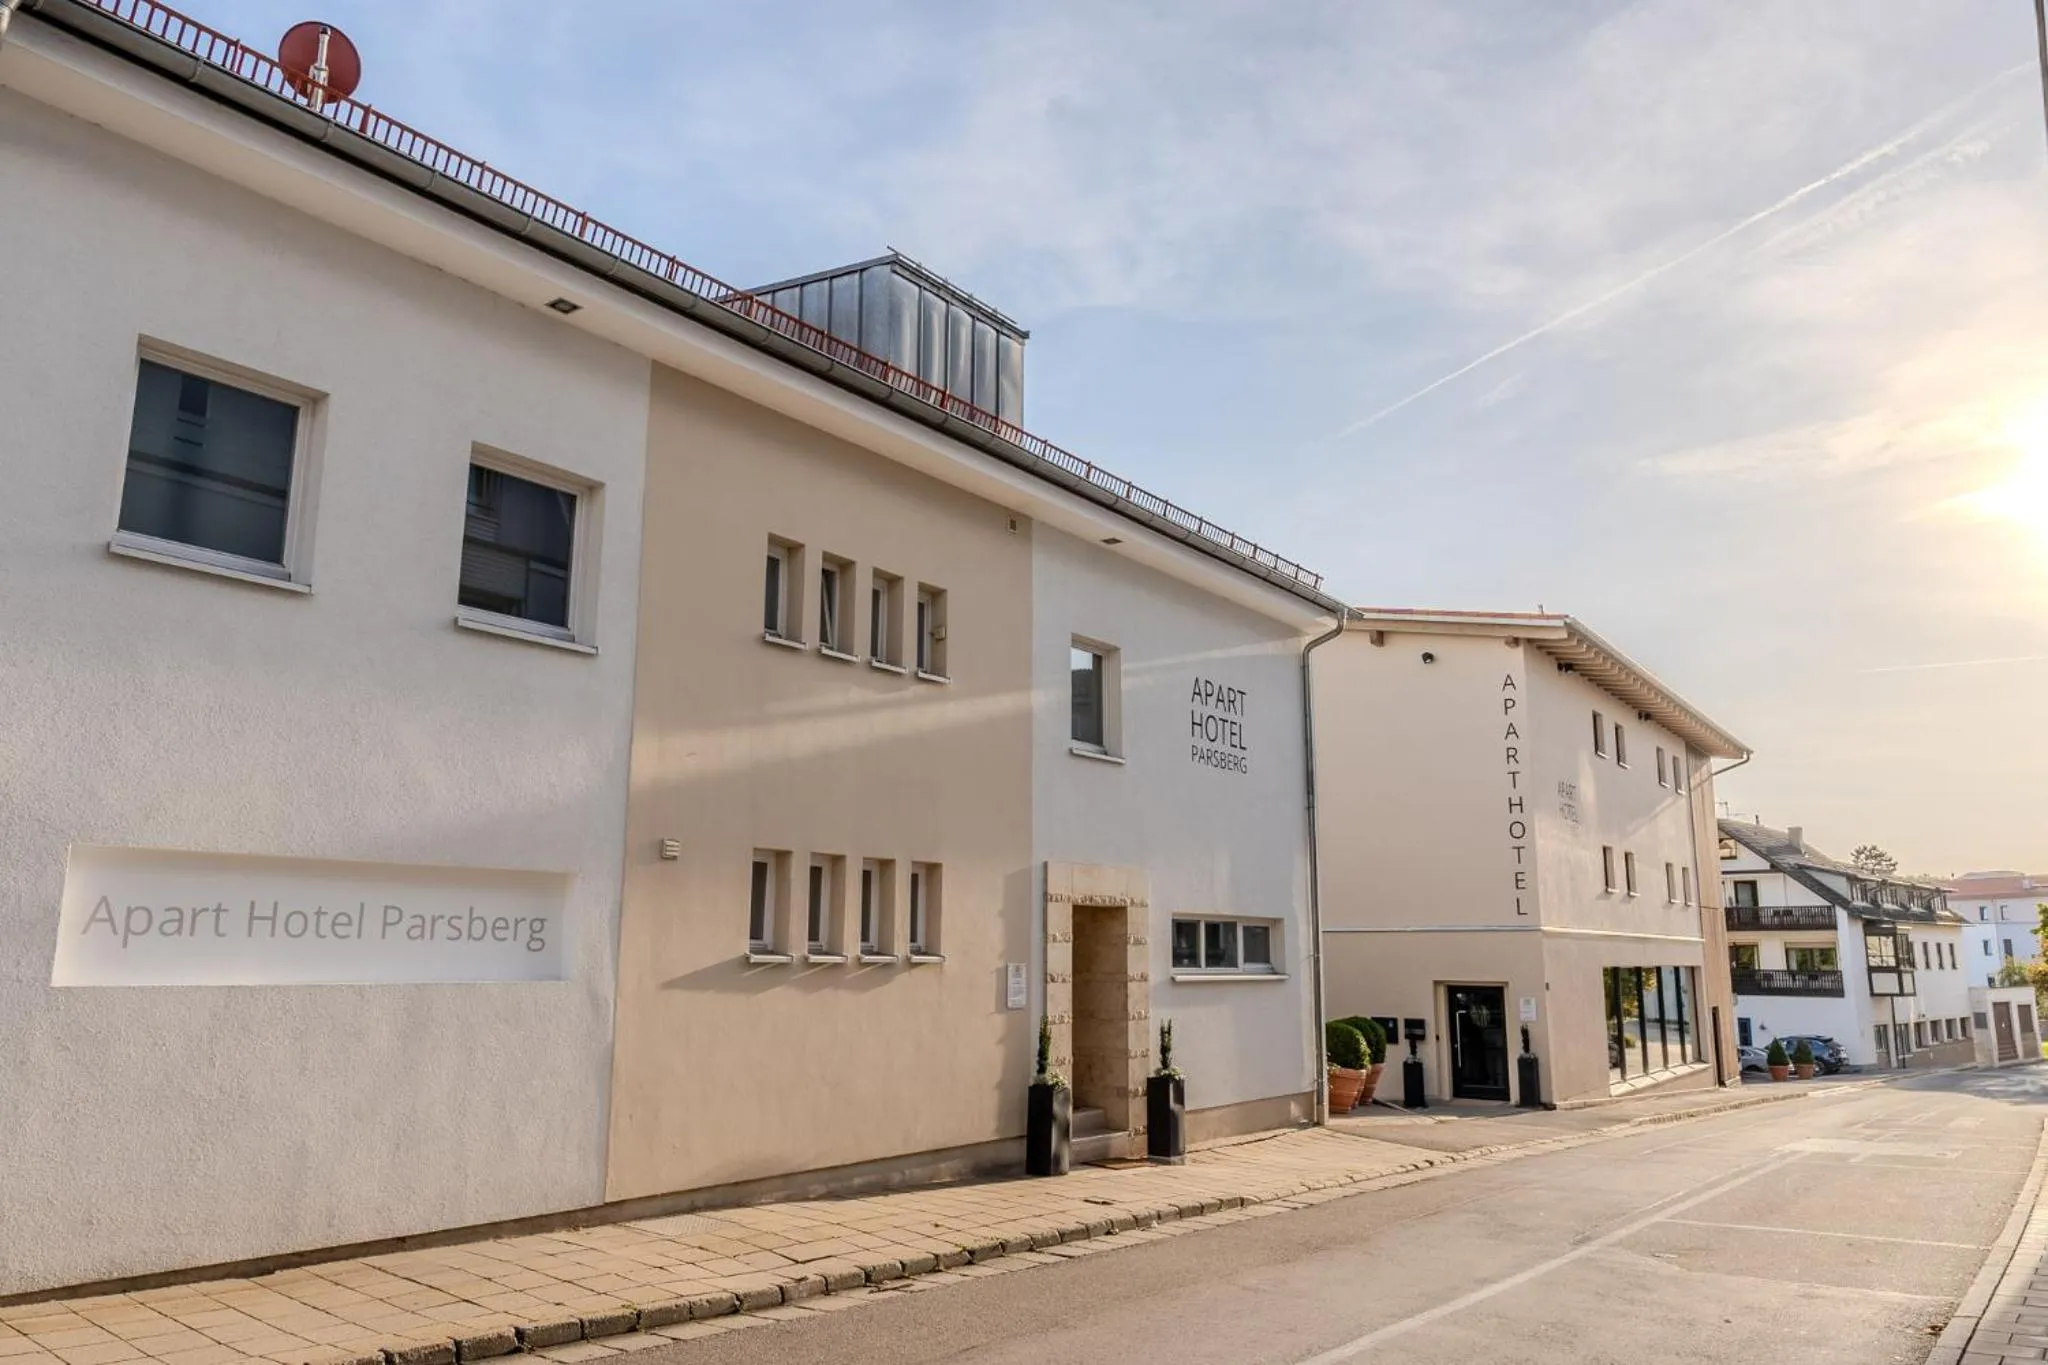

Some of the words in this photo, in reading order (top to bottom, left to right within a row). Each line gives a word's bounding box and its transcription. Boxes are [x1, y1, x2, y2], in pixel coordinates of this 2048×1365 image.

[1191, 676, 1246, 717] APART
[1191, 709, 1247, 750] HOTEL
[1191, 744, 1247, 774] PARSBERG
[81, 894, 229, 949] Apart
[247, 900, 365, 940] Hotel
[380, 904, 548, 952] Parsberg
